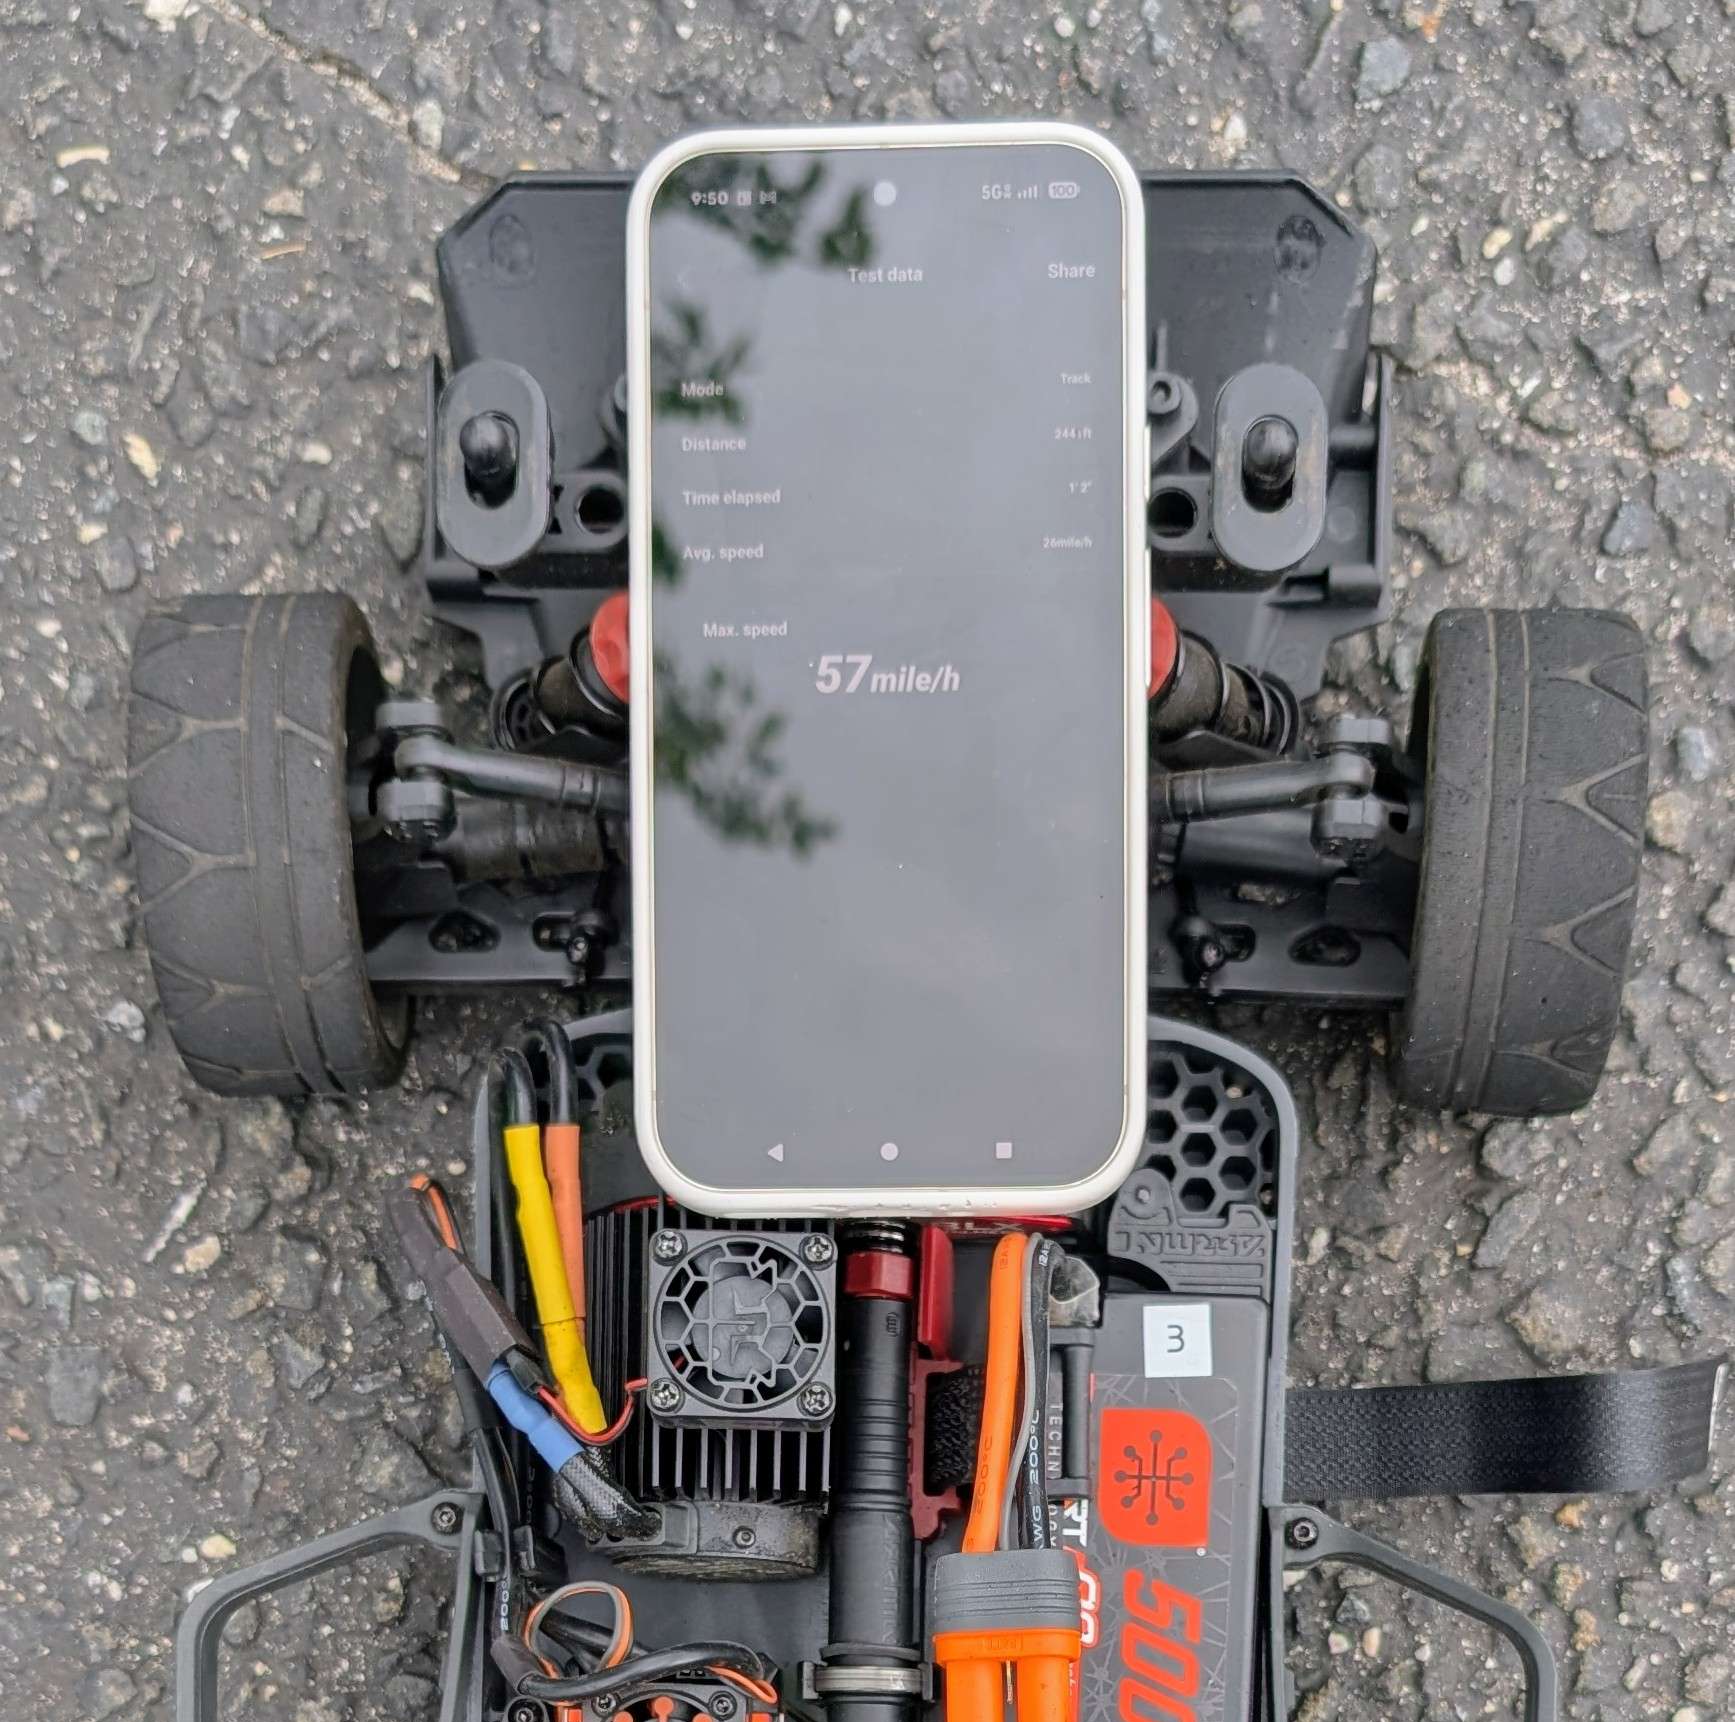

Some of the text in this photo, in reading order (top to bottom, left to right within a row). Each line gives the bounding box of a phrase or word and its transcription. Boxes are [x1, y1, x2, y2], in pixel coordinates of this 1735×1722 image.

[691, 191, 729, 206] 9:50
[848, 266, 924, 284] Test data
[1047, 262, 1097, 280] Share
[1060, 372, 1092, 385] Track
[681, 382, 724, 397] Mode
[681, 436, 747, 452] Distance
[682, 489, 781, 507] Time elapsed
[1042, 536, 1093, 549] 26mile/h
[682, 544, 764, 562] Avg. speed
[702, 621, 788, 639] Max. speed
[815, 654, 960, 694] 57 mile/h
[1166, 1324, 1186, 1354] 3
